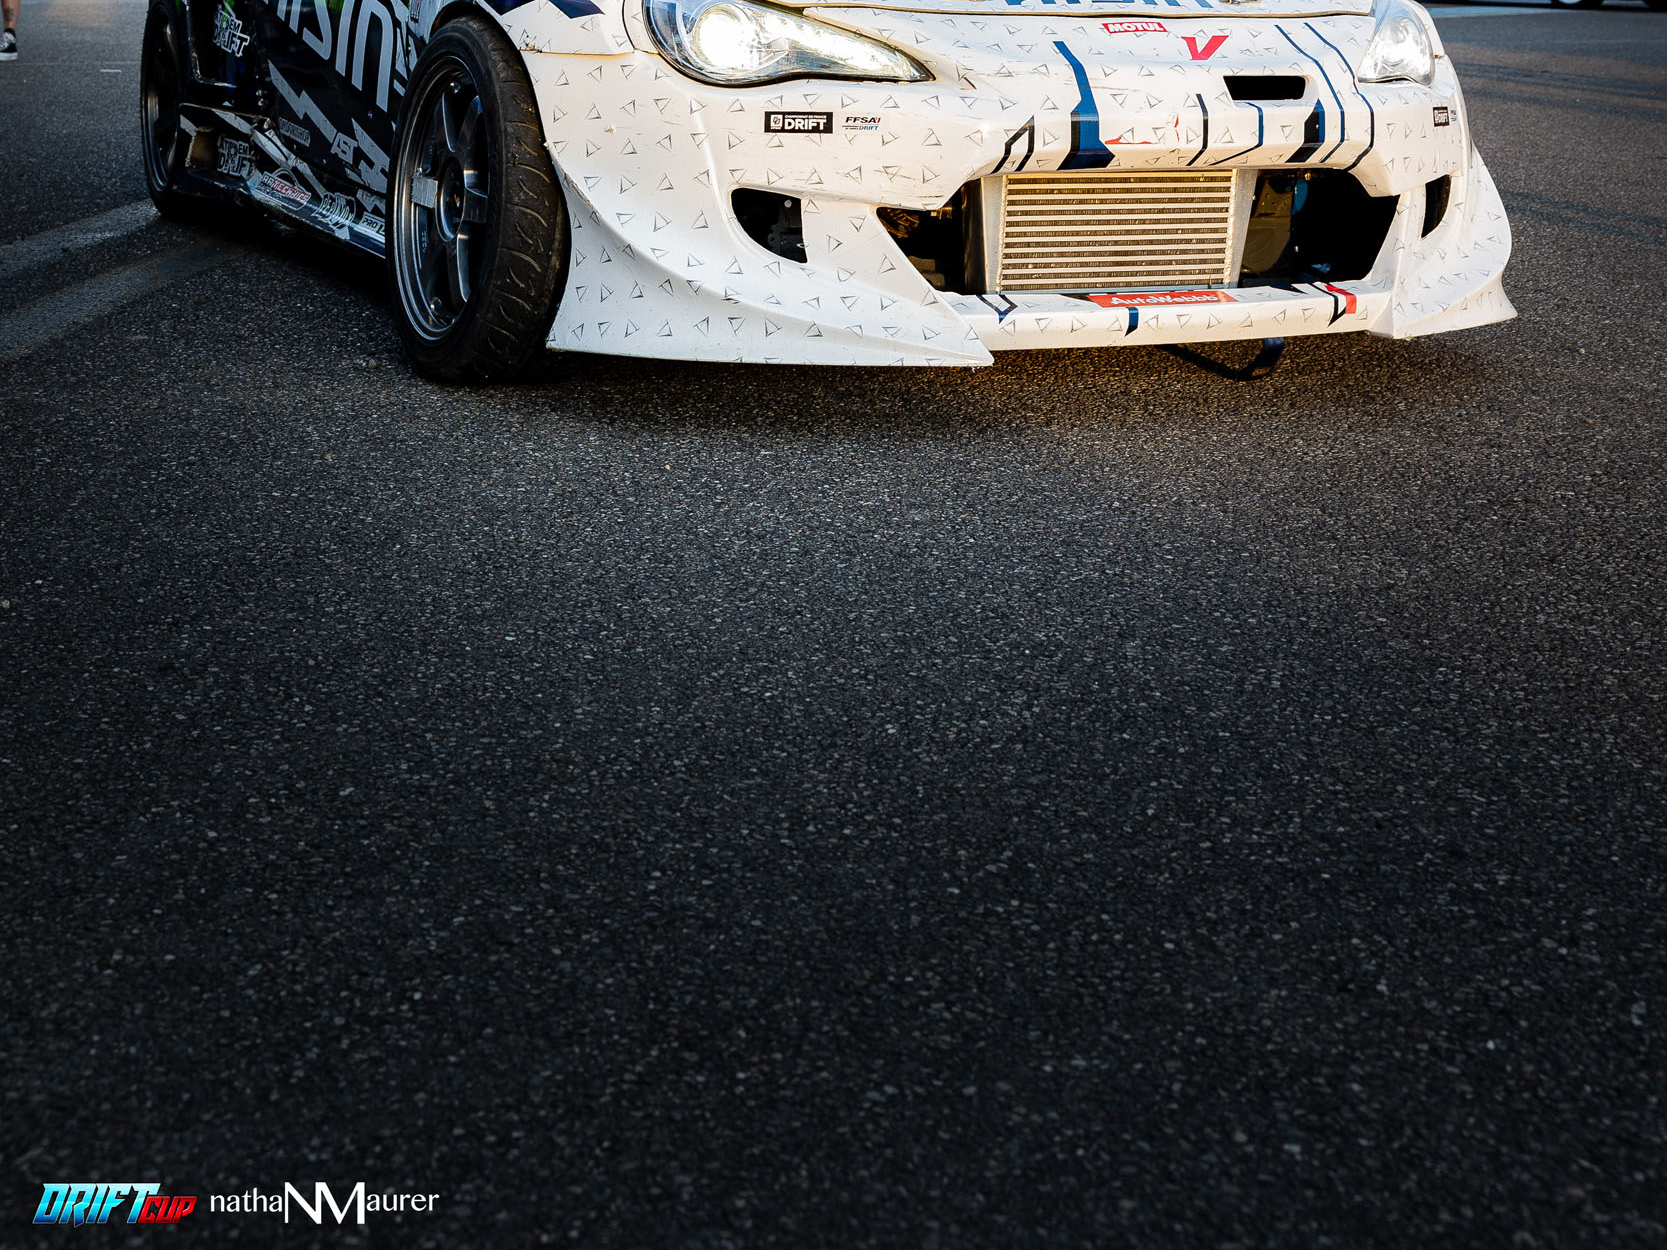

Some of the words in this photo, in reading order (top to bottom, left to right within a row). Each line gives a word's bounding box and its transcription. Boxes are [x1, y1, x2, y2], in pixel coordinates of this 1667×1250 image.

[1107, 22, 1166, 33] MOTUL
[784, 119, 827, 130] DRIFT
[846, 116, 876, 124] FFSA
[362, 218, 378, 230] PRO
